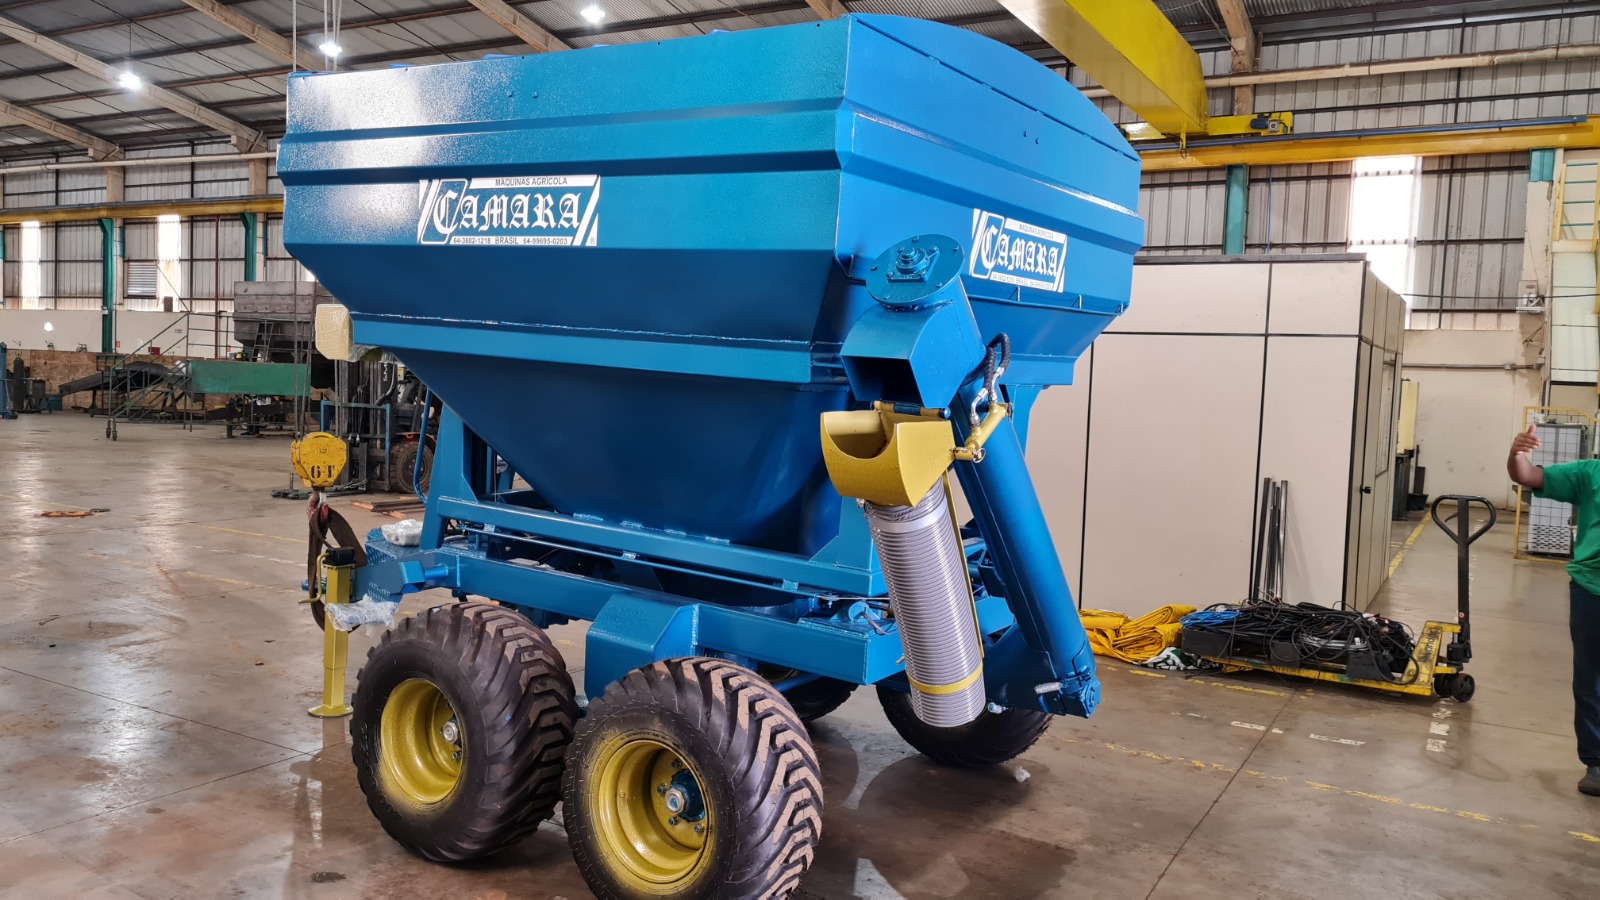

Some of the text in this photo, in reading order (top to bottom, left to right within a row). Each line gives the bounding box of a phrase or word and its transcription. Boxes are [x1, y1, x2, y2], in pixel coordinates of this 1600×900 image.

[433, 190, 581, 234] CAMARA
[495, 236, 518, 244] BRASIL
[981, 224, 1059, 278] CAMARA
